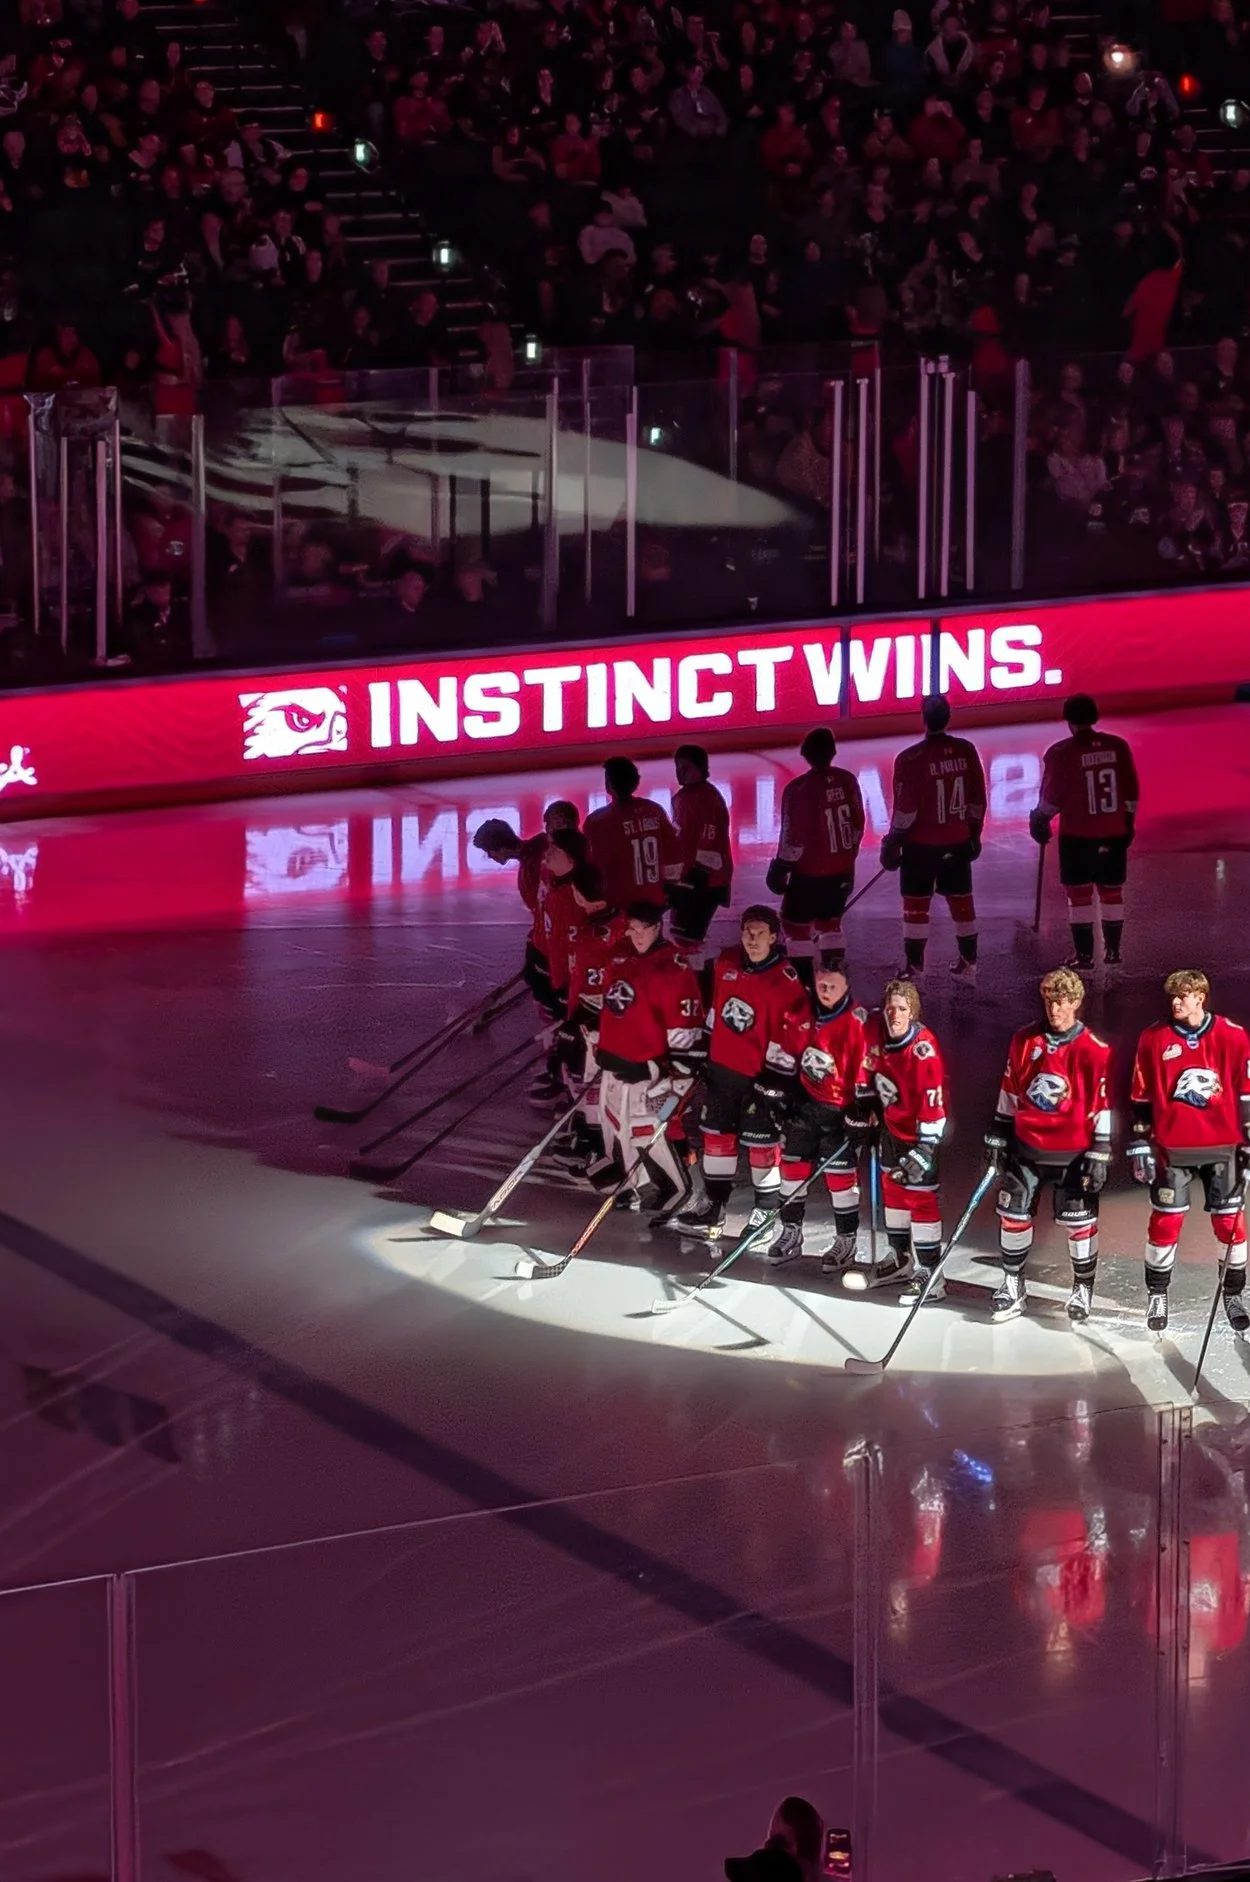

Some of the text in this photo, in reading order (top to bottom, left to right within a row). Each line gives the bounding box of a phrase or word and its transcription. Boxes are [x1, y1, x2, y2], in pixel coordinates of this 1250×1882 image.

[367, 624, 1064, 750] INSTINCT WINS.
[935, 776, 967, 824] 14
[1085, 768, 1118, 815] 13
[825, 804, 853, 853] 16
[631, 836, 660, 886] 19
[569, 926, 578, 942] 2
